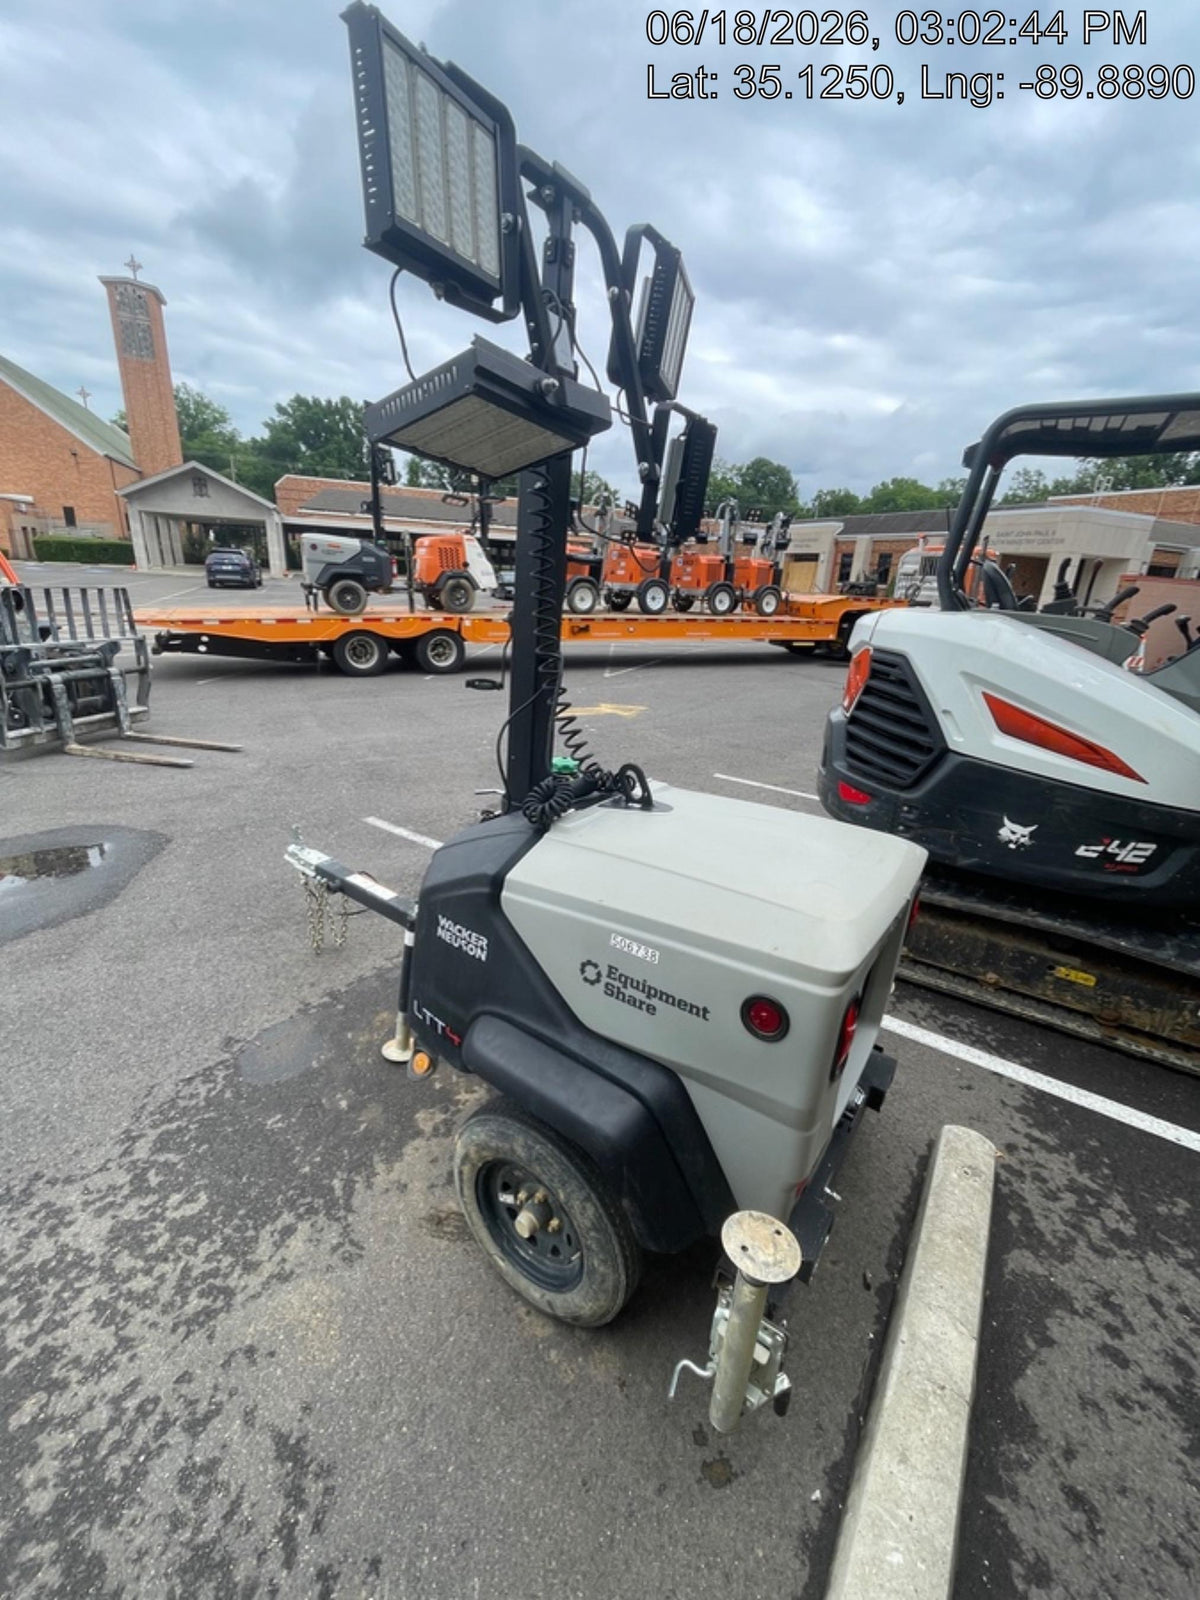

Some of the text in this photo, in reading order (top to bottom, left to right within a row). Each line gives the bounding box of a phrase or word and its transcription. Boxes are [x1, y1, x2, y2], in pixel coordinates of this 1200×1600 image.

[436, 925, 488, 962] NEUSON
[438, 914, 488, 948] WACKER
[603, 981, 657, 1016] Share
[605, 964, 711, 1021] Equipment
